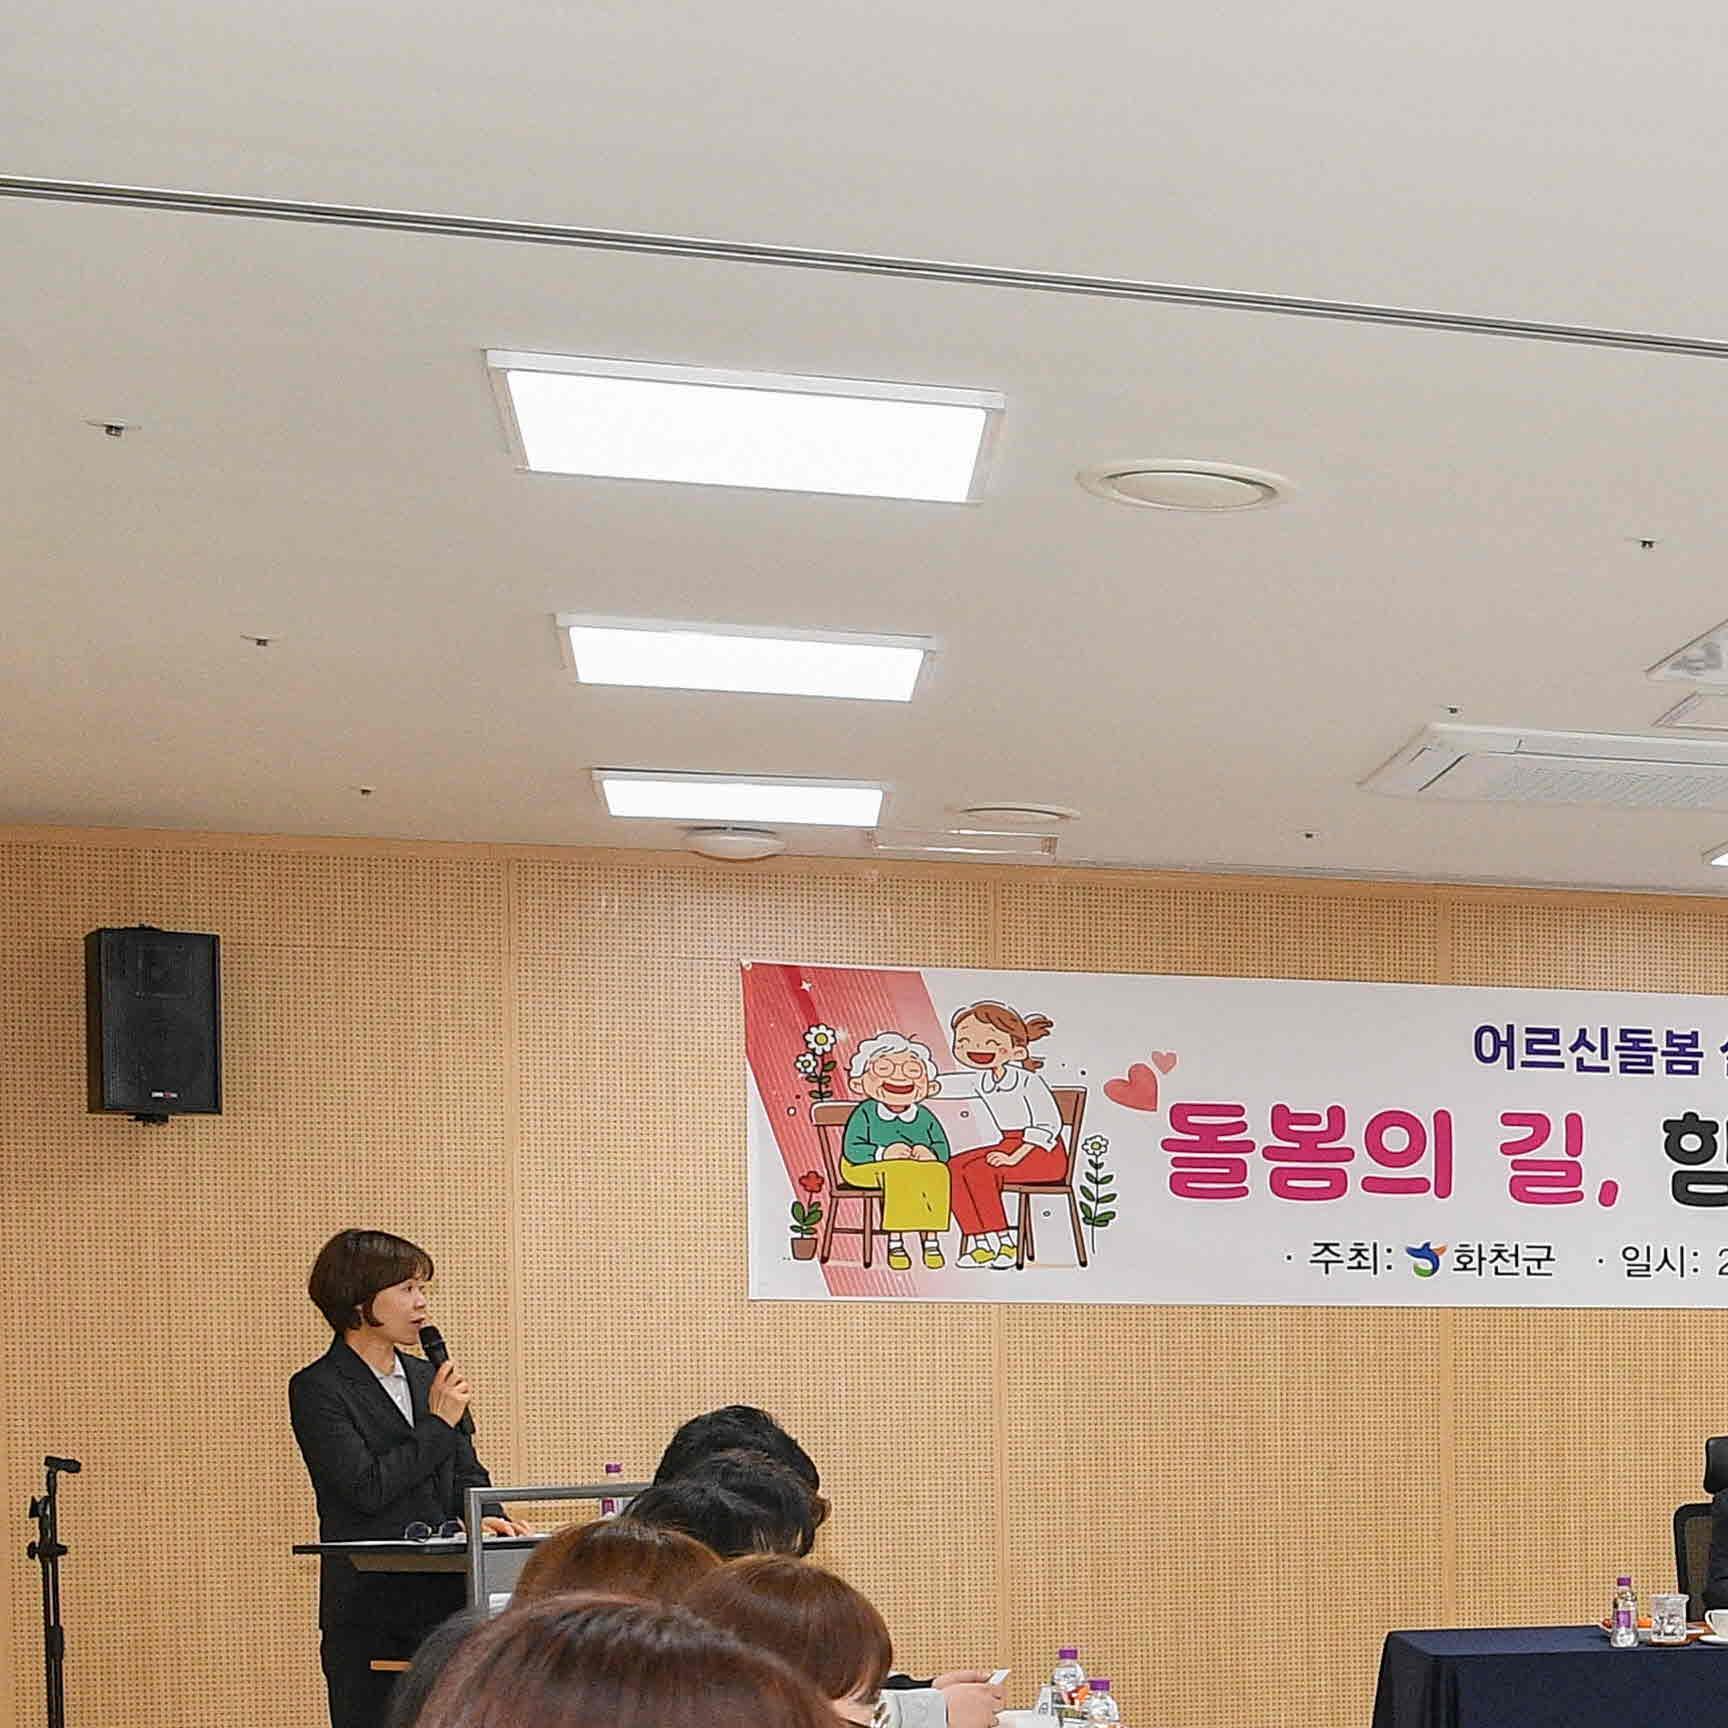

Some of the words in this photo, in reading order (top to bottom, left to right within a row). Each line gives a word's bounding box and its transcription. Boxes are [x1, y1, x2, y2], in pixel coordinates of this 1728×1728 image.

[1473, 1023, 1704, 1076] 어르신돌봄
[1161, 1102, 1453, 1201] 돌봄의
[1500, 1111, 1620, 1207] 길,
[1309, 1241, 1393, 1276] 주최:
[1452, 1243, 1556, 1277] 화천군
[1621, 1245, 1699, 1278] 일시:
